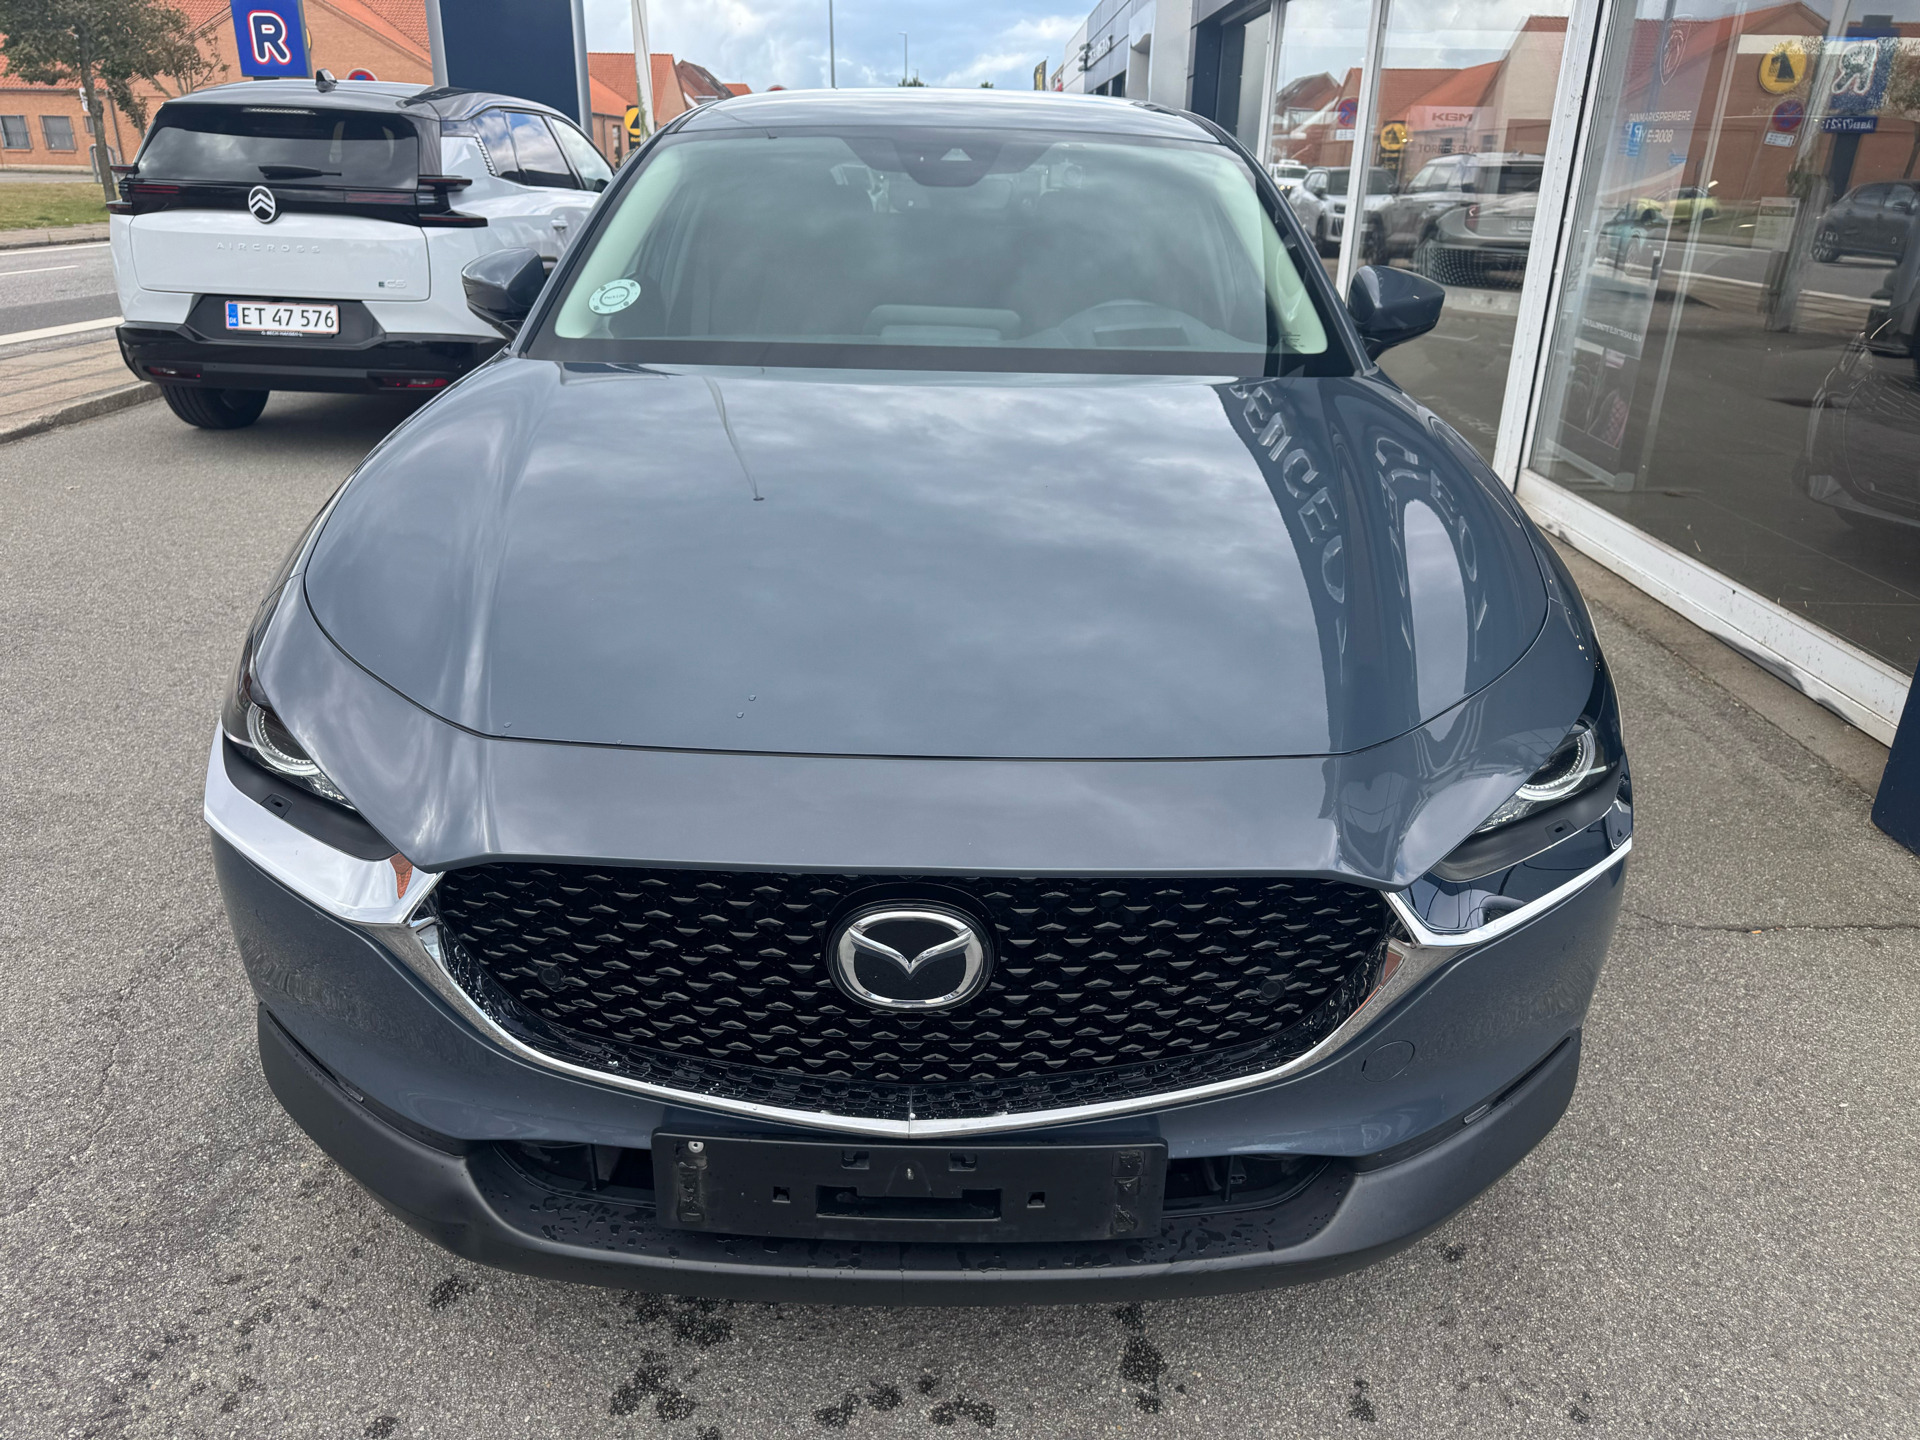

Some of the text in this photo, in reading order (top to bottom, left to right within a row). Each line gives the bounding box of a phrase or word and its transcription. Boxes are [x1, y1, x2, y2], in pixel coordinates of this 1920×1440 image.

[247, 10, 292, 65] R
[1432, 112, 1473, 122] KGM
[216, 242, 321, 254] AIRCROSS
[241, 307, 335, 329] ET 47 576
